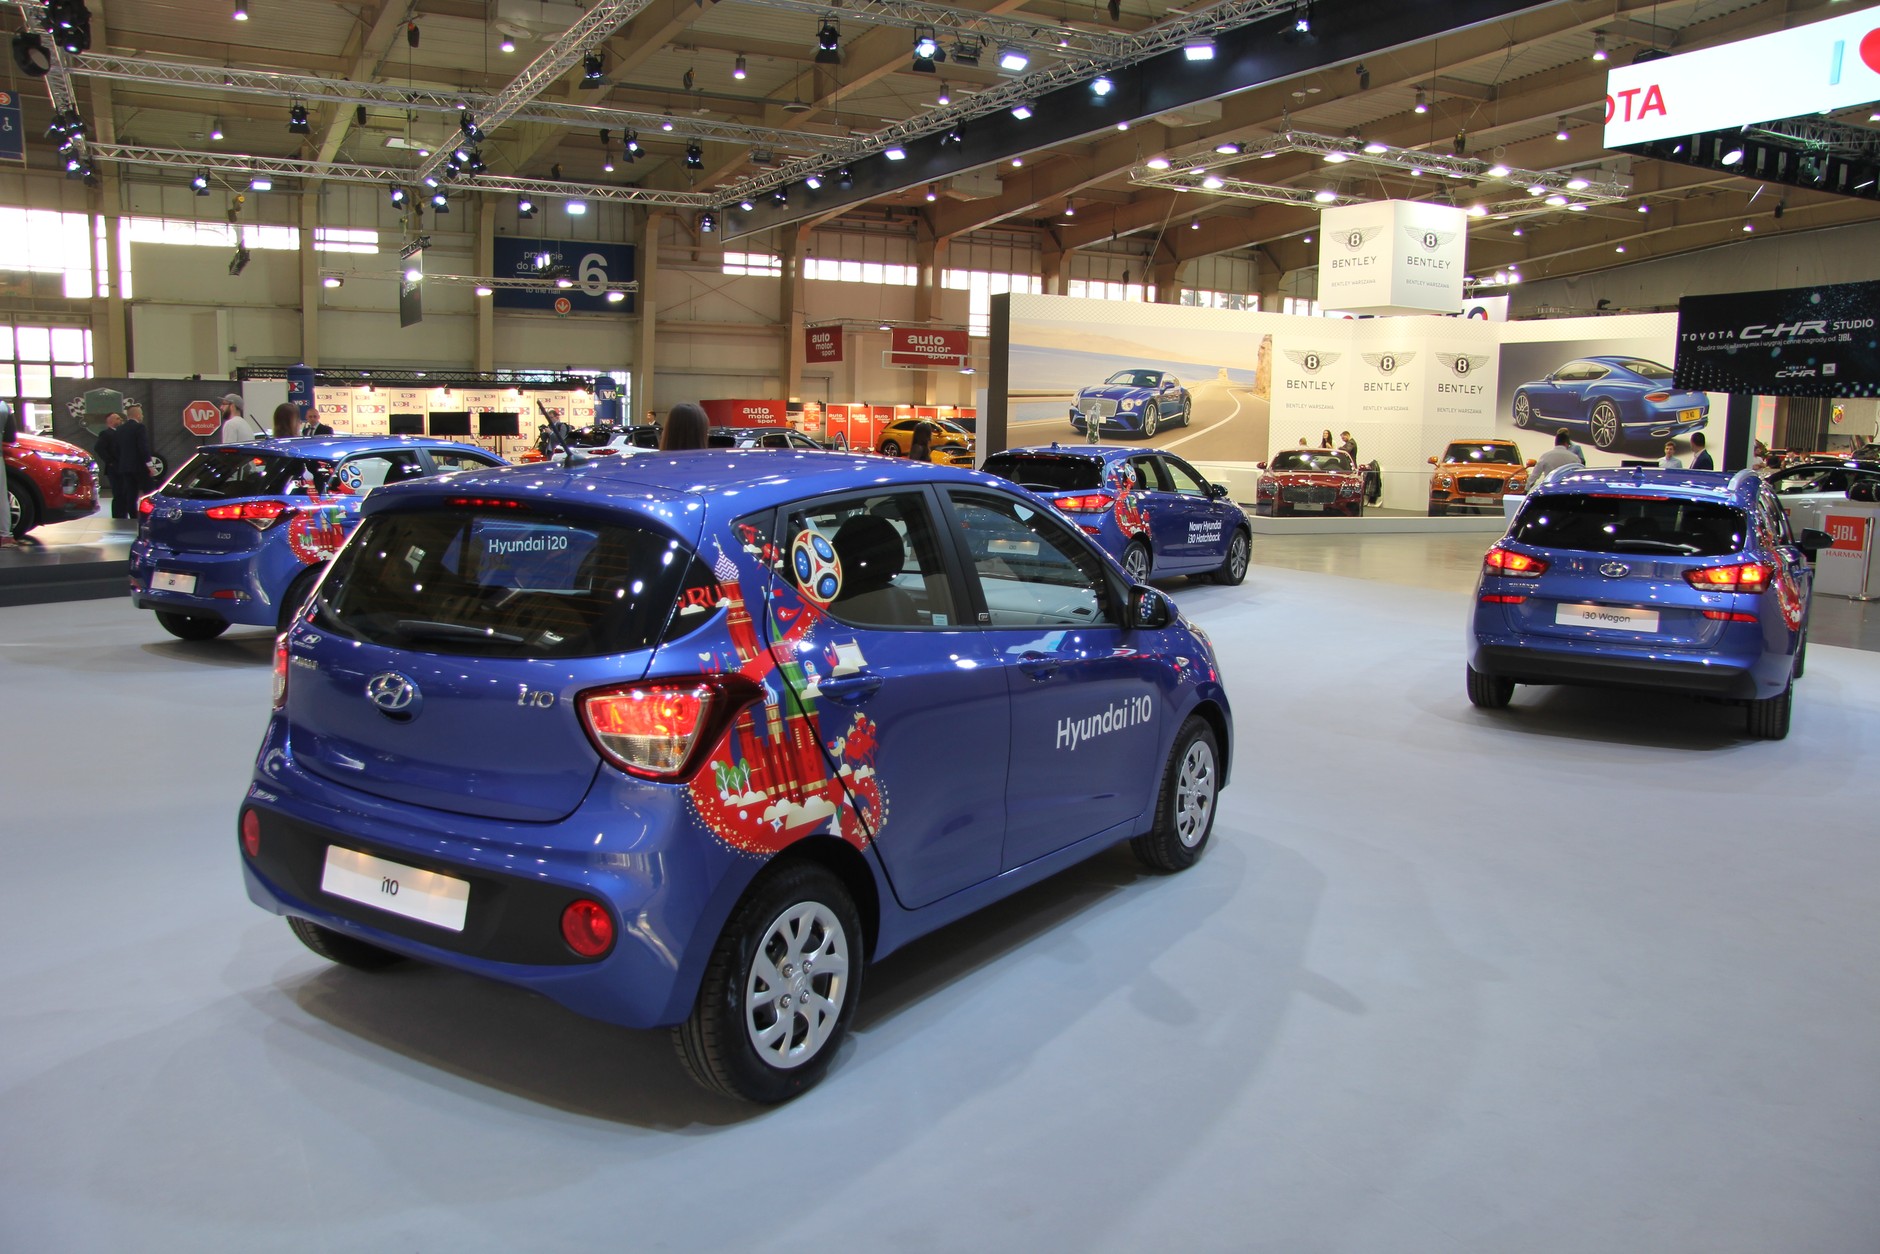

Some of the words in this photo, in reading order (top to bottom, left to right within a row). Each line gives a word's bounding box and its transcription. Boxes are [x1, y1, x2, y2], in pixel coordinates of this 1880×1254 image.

[517, 261, 529, 270] do
[1332, 256, 1377, 268] BENTLEY
[1407, 256, 1451, 269] BENTLEY
[578, 253, 609, 296] 6
[1682, 330, 1734, 342] TOYOTA
[1739, 320, 1828, 340] C-HR
[1833, 318, 1874, 331] STUDIO
[812, 332, 831, 343] auto
[908, 334, 945, 345] auto
[816, 342, 834, 350] motor
[915, 345, 951, 353] motor
[1286, 380, 1335, 391] BENTLEY
[1364, 382, 1410, 391] BENTLEY
[1438, 383, 1483, 394] BENTLEY
[320, 405, 346, 413] VOX
[359, 405, 384, 413] VOX
[1189, 521, 1203, 532] Nowy
[1203, 520, 1222, 532] Hyundai
[1188, 533, 1196, 543] i30
[1196, 532, 1221, 543] Hatchback
[1833, 525, 1857, 541] JBL
[488, 536, 545, 554] Hyundai
[547, 535, 568, 550] i20
[1825, 549, 1862, 559] HARMAN
[1582, 611, 1596, 620] i30
[1598, 612, 1631, 624] Wagon
[518, 687, 554, 708] i10
[1056, 699, 1128, 751] Hyundai
[1131, 695, 1152, 726] i10
[381, 876, 399, 896] i10
